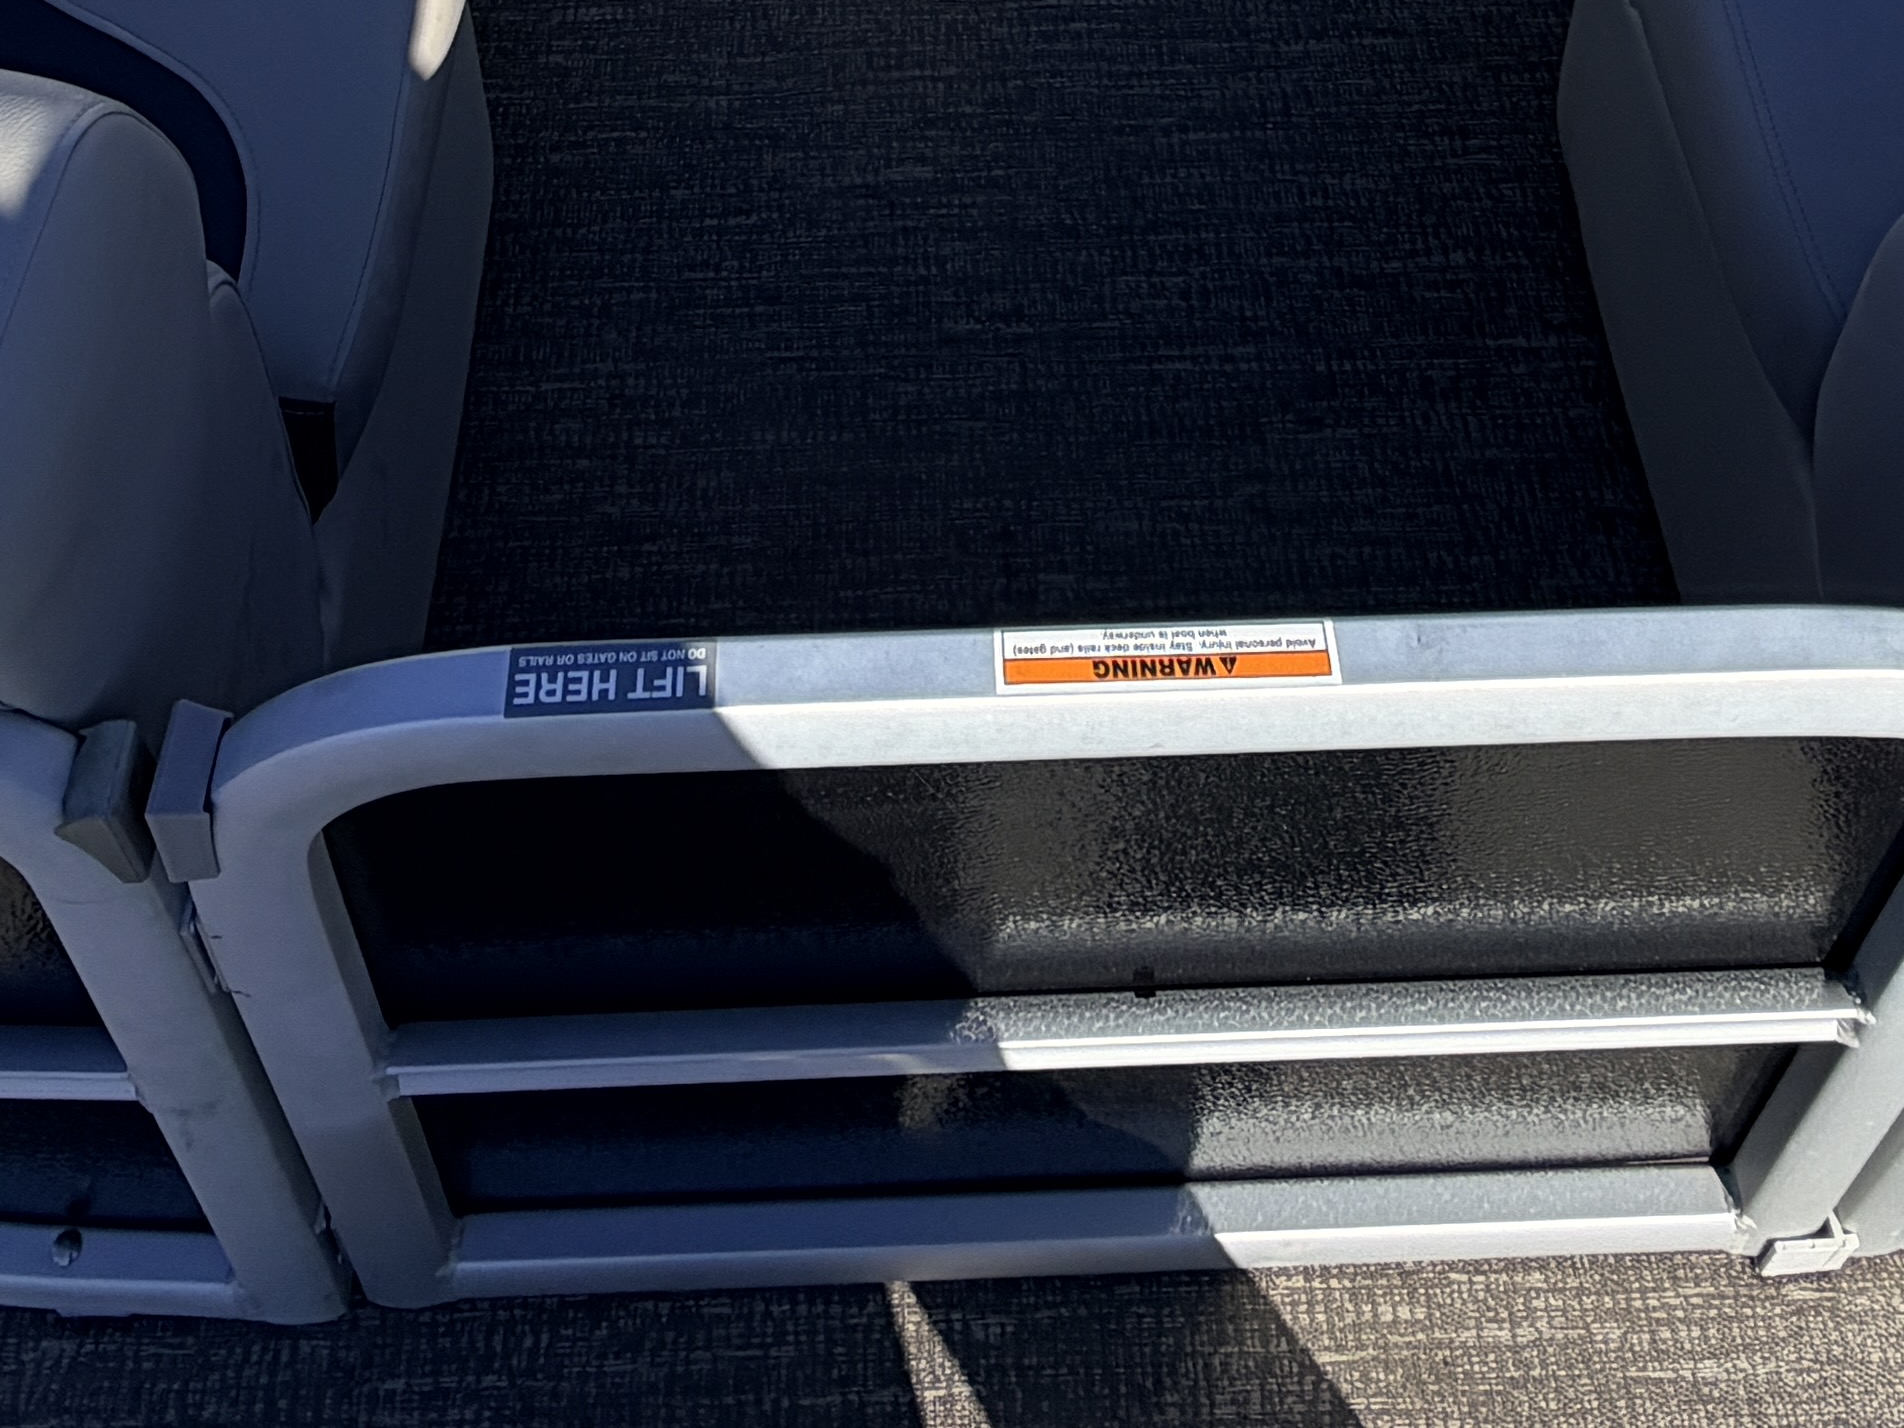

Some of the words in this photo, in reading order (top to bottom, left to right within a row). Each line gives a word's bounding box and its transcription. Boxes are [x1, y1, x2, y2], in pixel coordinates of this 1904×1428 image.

[1158, 630, 1168, 640] is
[1172, 629, 1196, 639] boat
[1198, 629, 1228, 639] when
[1050, 643, 1074, 656] (and
[1078, 644, 1101, 654] rails
[1104, 643, 1129, 654] deck
[1132, 642, 1166, 653] inside
[1169, 640, 1193, 652] Stay
[1235, 637, 1283, 650] personal
[1286, 638, 1316, 649] Avoid
[618, 650, 637, 662] ON
[639, 650, 658, 662] SIT
[660, 649, 685, 661] NOT
[687, 647, 706, 660] DO
[1013, 643, 1047, 657] gates)
[518, 655, 554, 668] RAILS
[557, 653, 575, 666] OR
[577, 651, 616, 665] GATES
[1092, 657, 1217, 678] WARNING
[513, 669, 617, 705] HERE
[627, 665, 708, 701] LIFT
